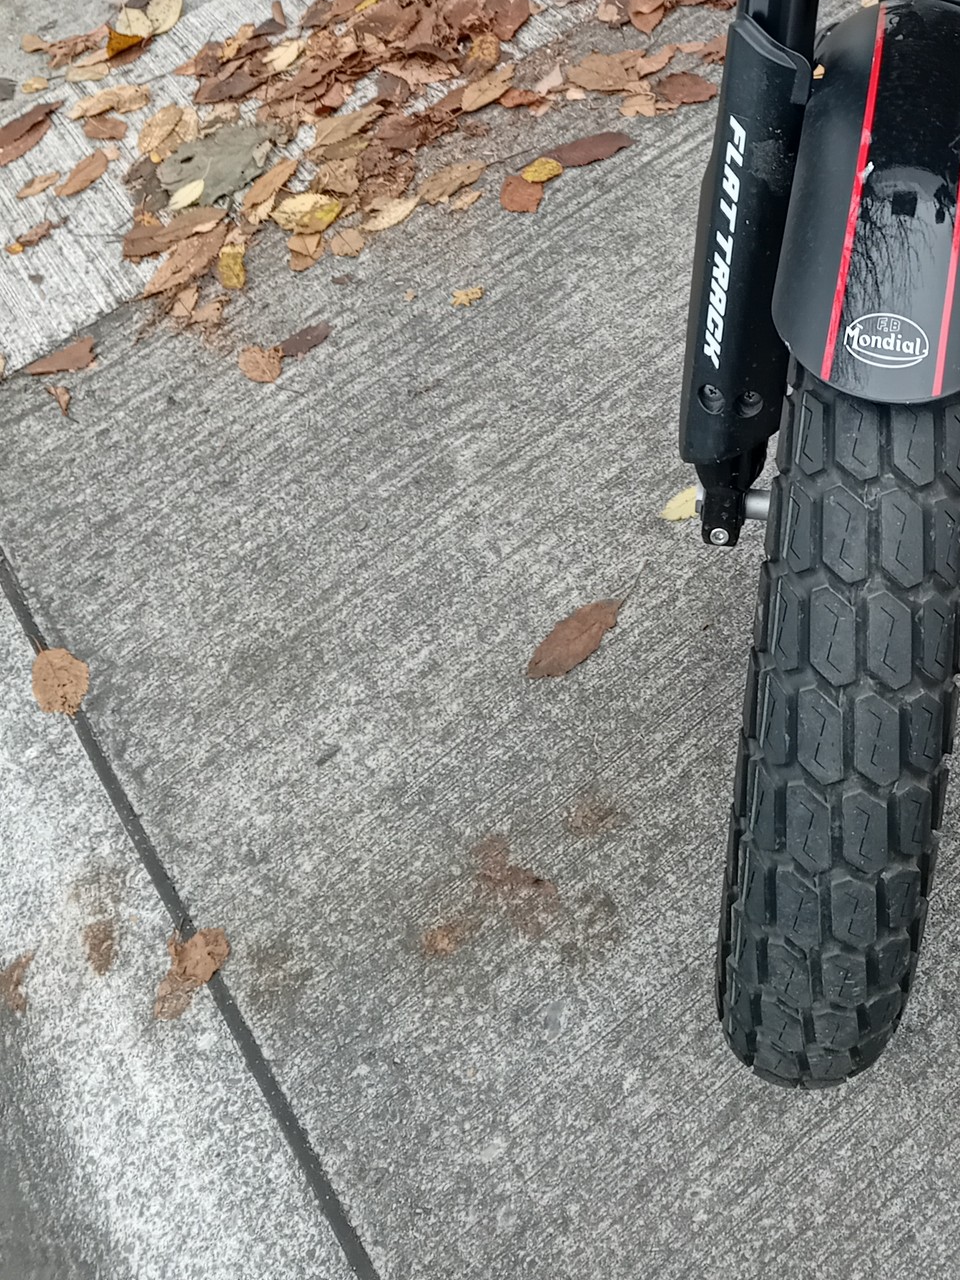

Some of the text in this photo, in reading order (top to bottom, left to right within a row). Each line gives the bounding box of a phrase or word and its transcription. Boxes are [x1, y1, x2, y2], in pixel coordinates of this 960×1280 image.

[703, 114, 747, 370] FLAT TRACK
[844, 323, 921, 356] Mondial
